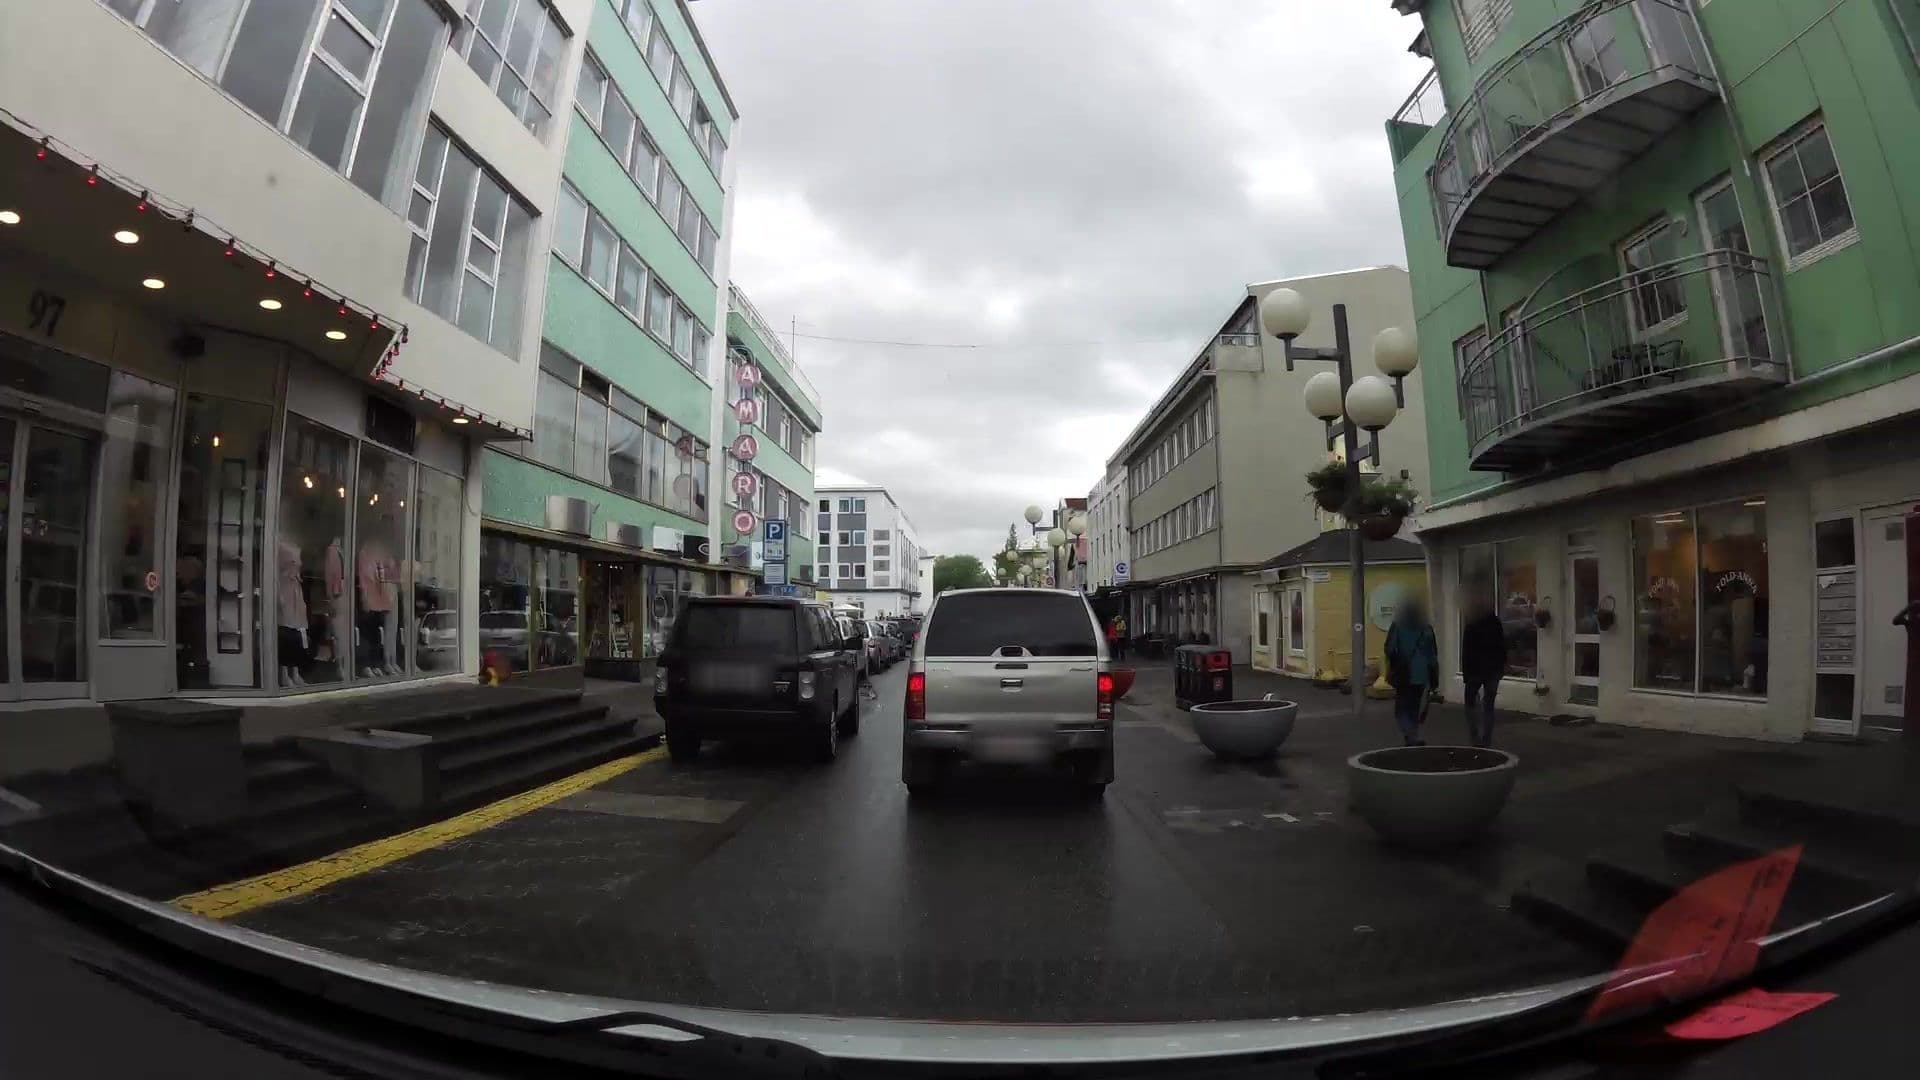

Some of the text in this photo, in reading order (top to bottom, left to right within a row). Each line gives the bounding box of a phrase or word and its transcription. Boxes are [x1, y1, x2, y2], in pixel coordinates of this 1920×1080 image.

[30, 289, 65, 336] 97
[734, 366, 756, 531] AMARO
[769, 524, 780, 538] P
